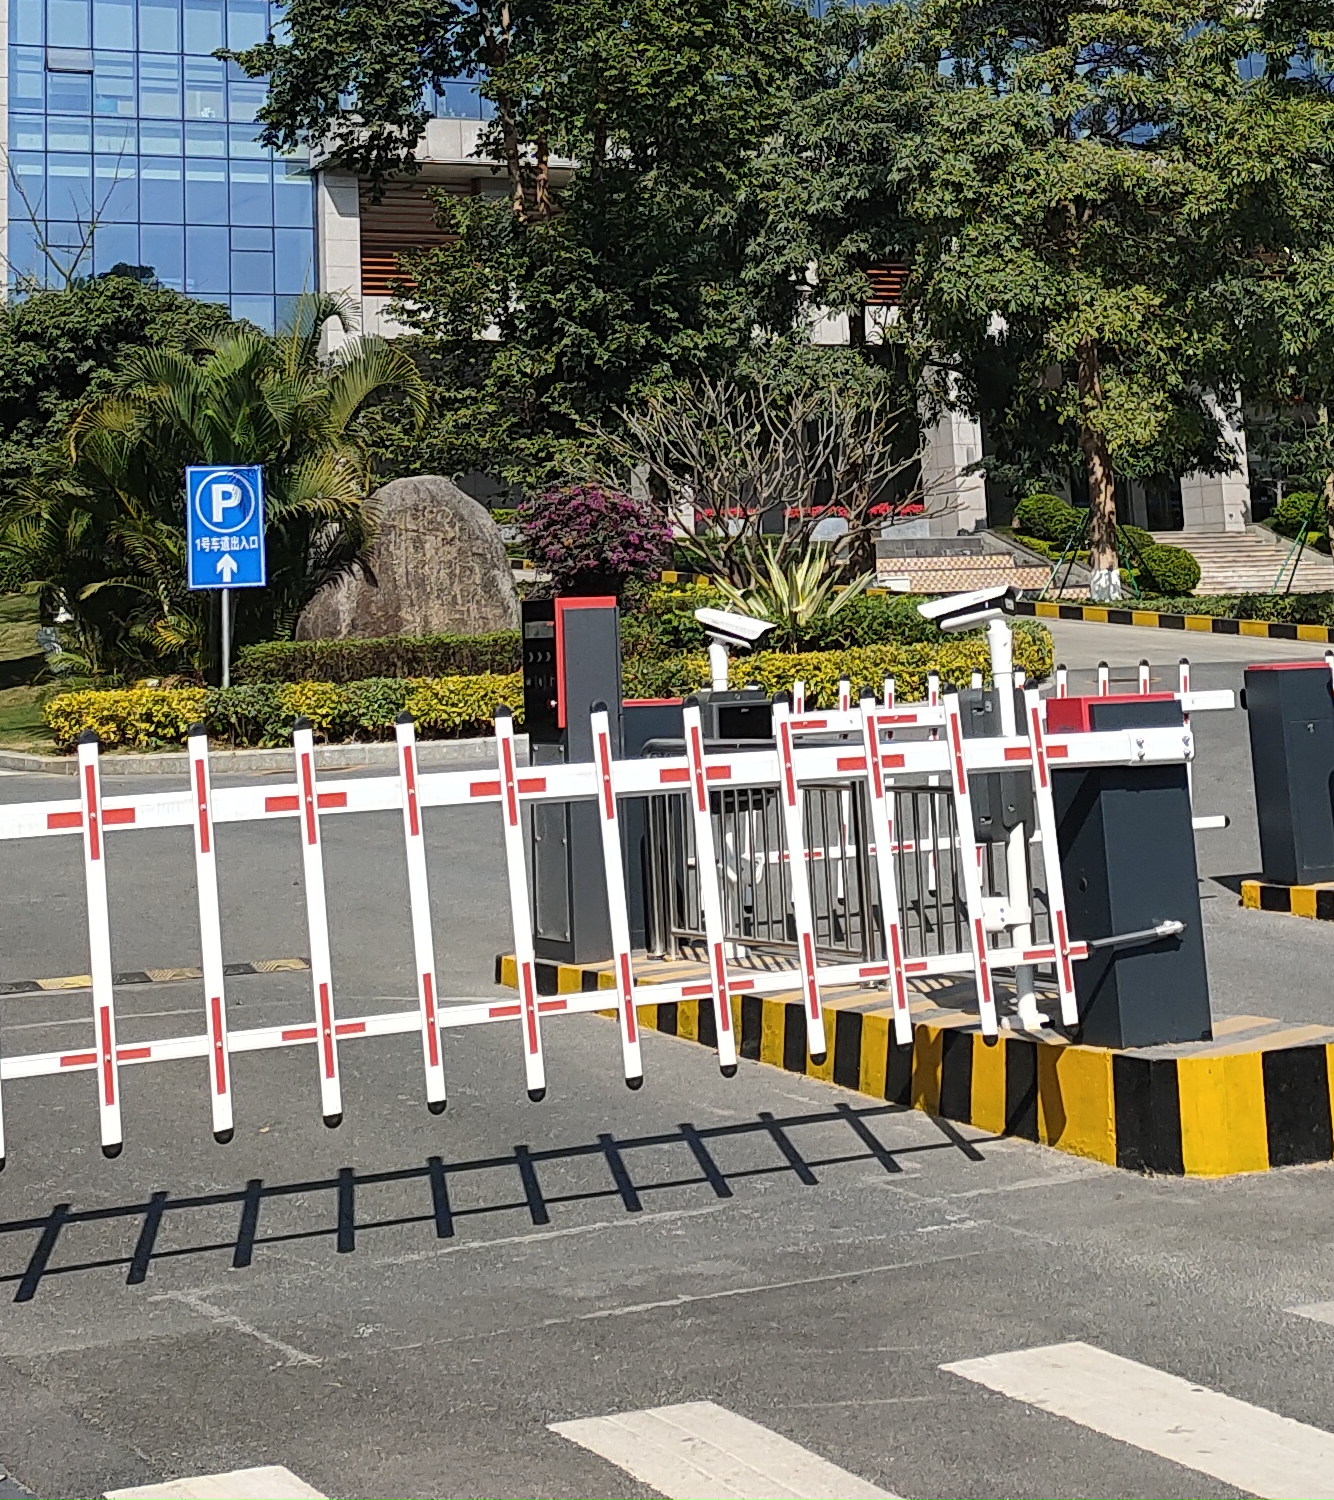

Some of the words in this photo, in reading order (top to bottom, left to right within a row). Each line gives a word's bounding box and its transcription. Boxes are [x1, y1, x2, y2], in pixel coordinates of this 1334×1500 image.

[211, 484, 242, 522] P
[195, 536, 259, 552] 1号车道出入口
